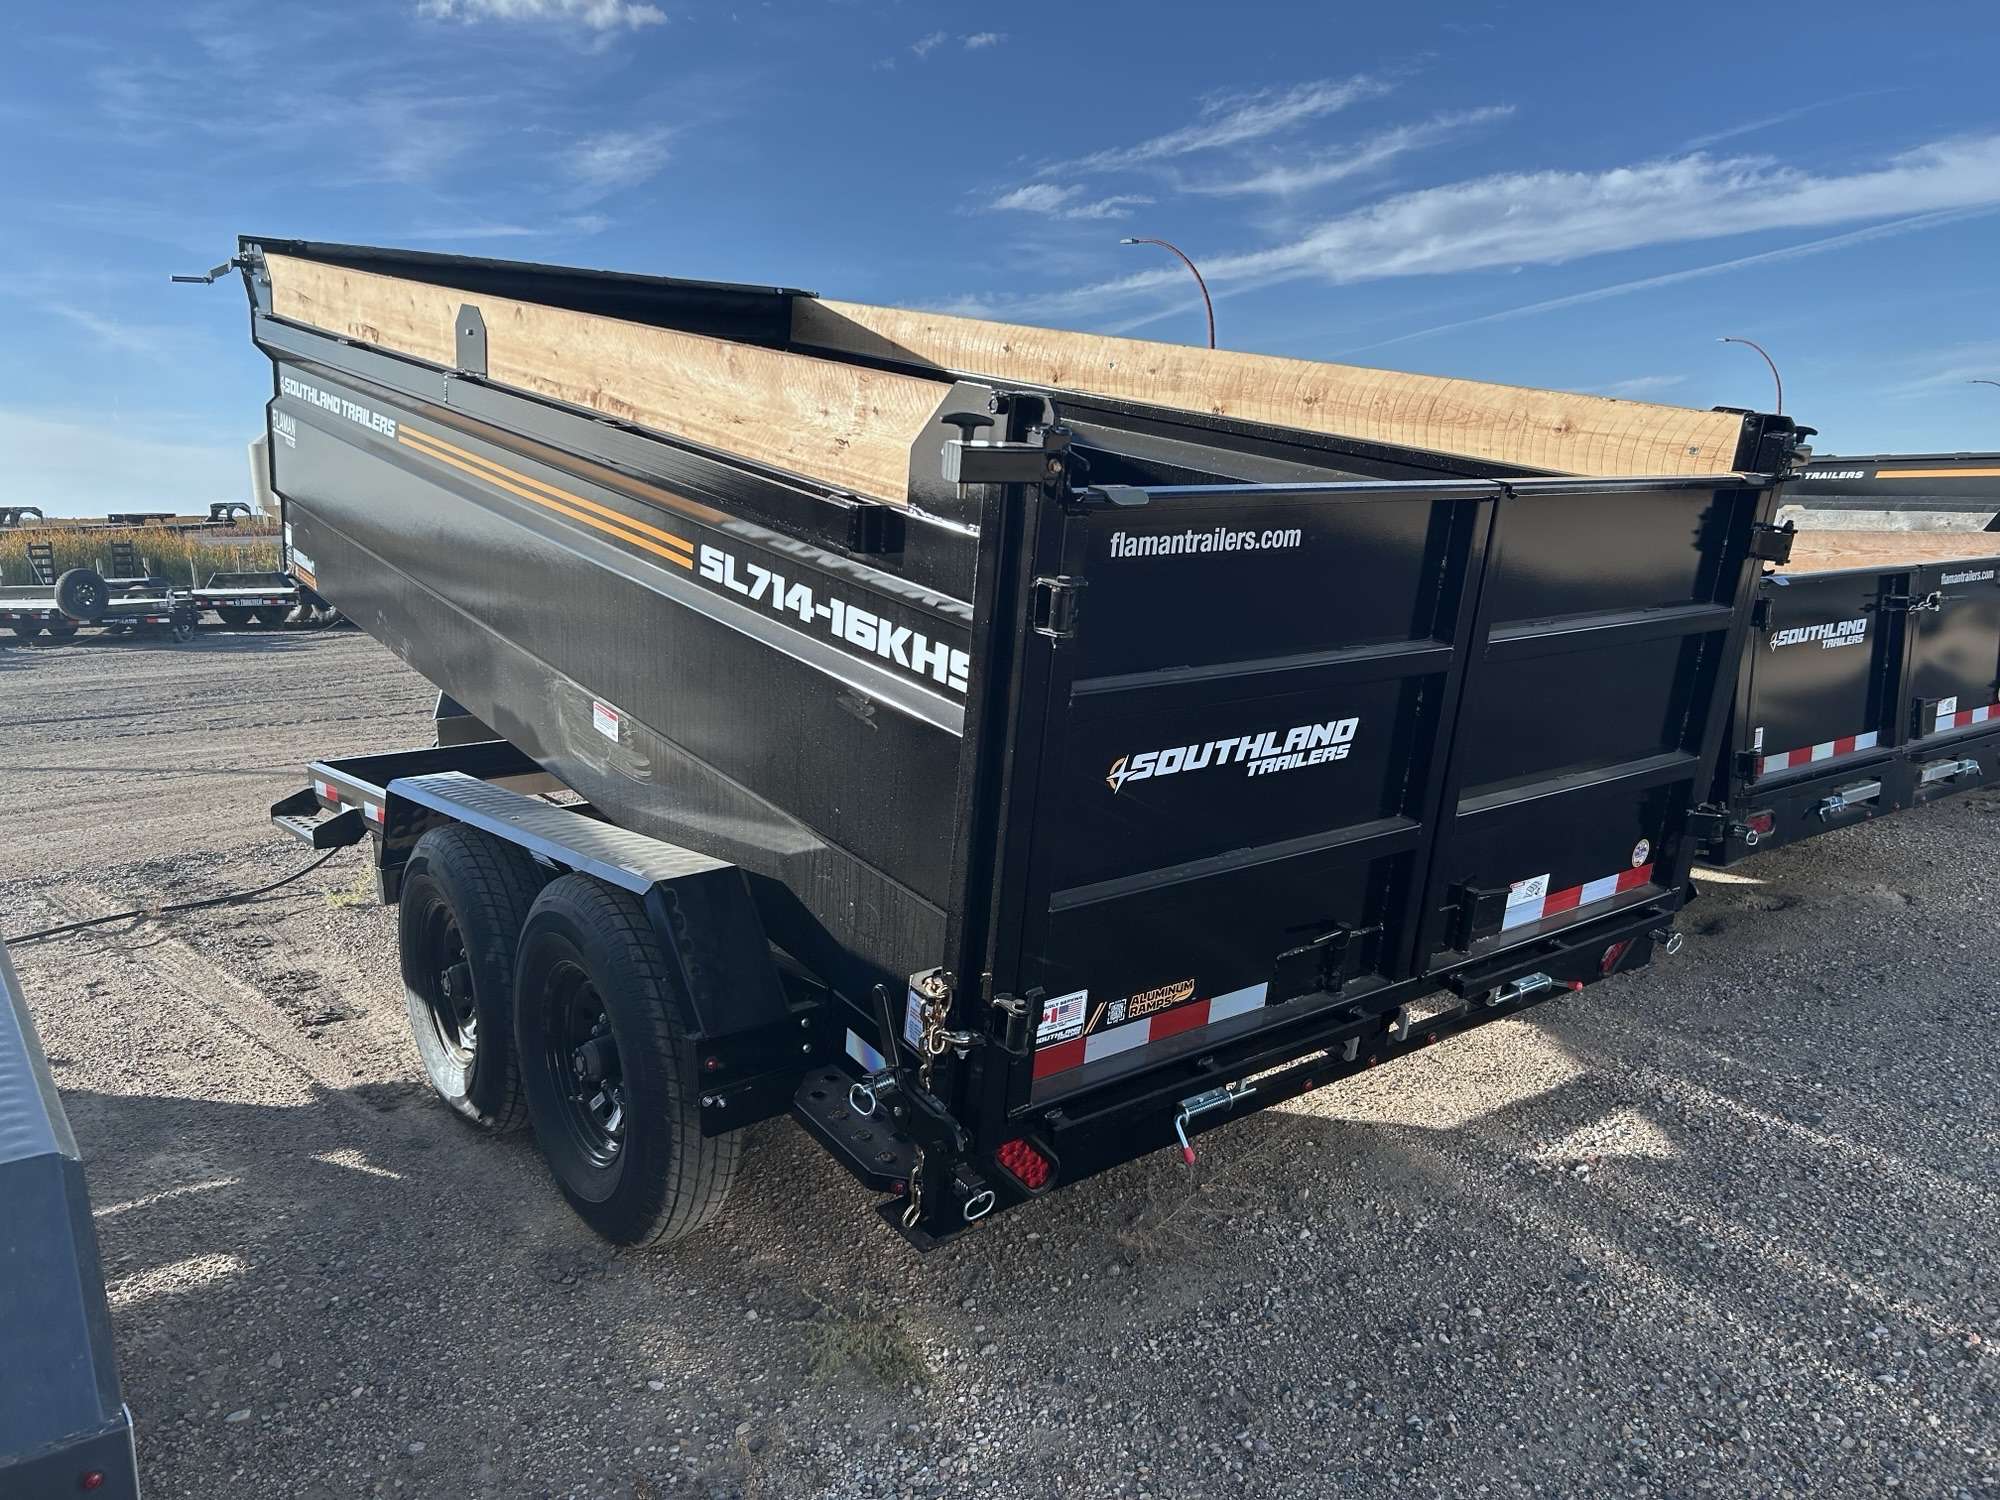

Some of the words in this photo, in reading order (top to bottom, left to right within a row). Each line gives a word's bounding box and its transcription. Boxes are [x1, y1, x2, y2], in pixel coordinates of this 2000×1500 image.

[283, 377, 341, 415] SOUTHLAND
[342, 399, 397, 439] TRAILERS
[1805, 470, 1865, 480] TRAILERS
[1110, 527, 1302, 558] flamantrailers.com
[700, 544, 970, 693] SL714-16KHS
[1777, 618, 1868, 647] SOUTHLAND
[1822, 633, 1865, 649] TRAILERS
[1127, 716, 1360, 782] SOUTHLAND
[1247, 743, 1351, 777] TRAILERS
[1128, 995, 1173, 1018] RAMPS
[1130, 978, 1195, 1007] ALUMINUM
